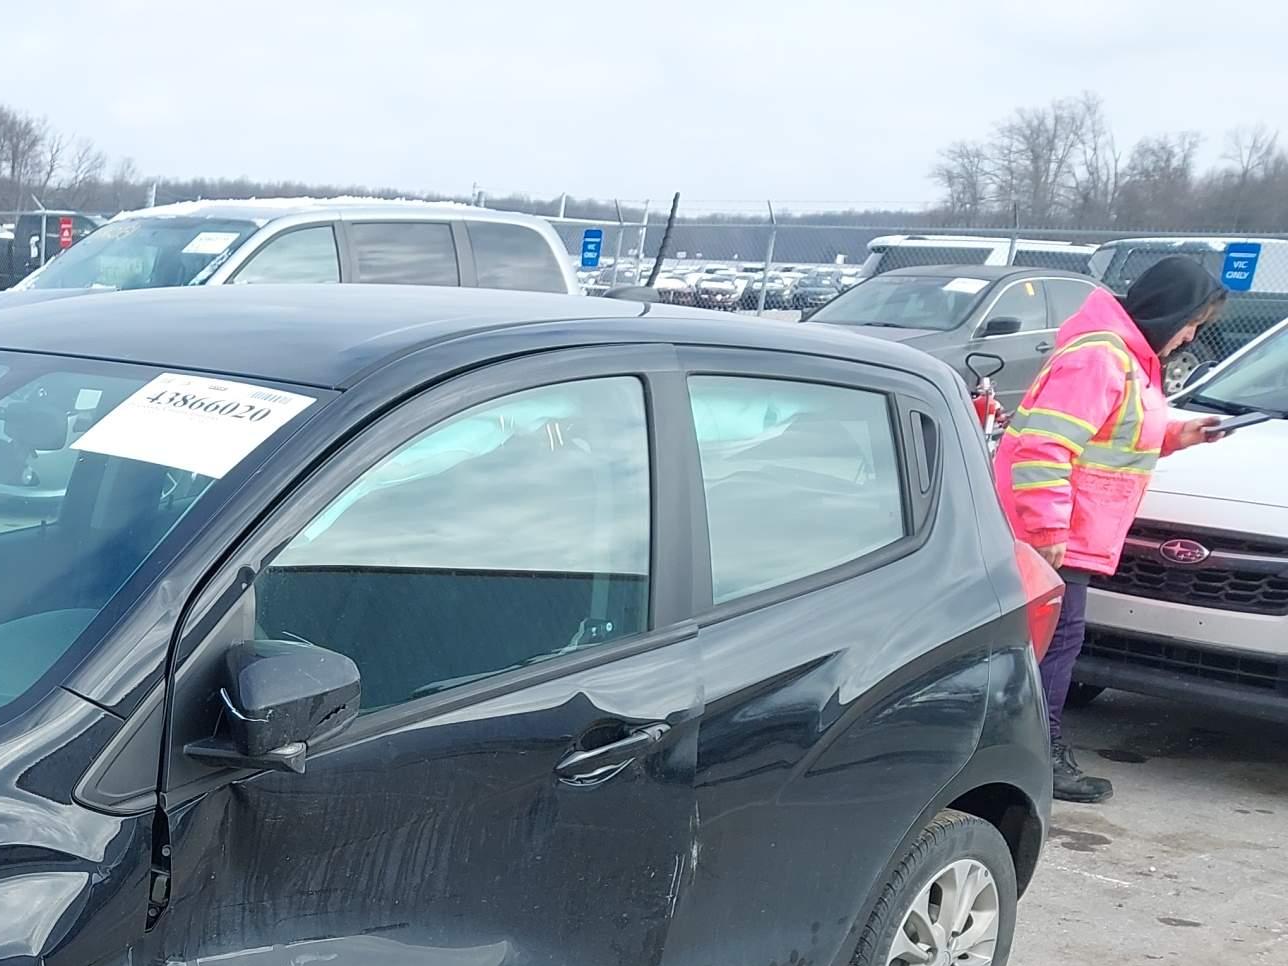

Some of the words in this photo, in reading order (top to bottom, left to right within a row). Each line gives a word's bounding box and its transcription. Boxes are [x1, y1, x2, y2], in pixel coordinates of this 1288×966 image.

[1233, 260, 1249, 269] VIC
[1225, 270, 1250, 280] ONLY
[146, 390, 272, 422] 43866020
